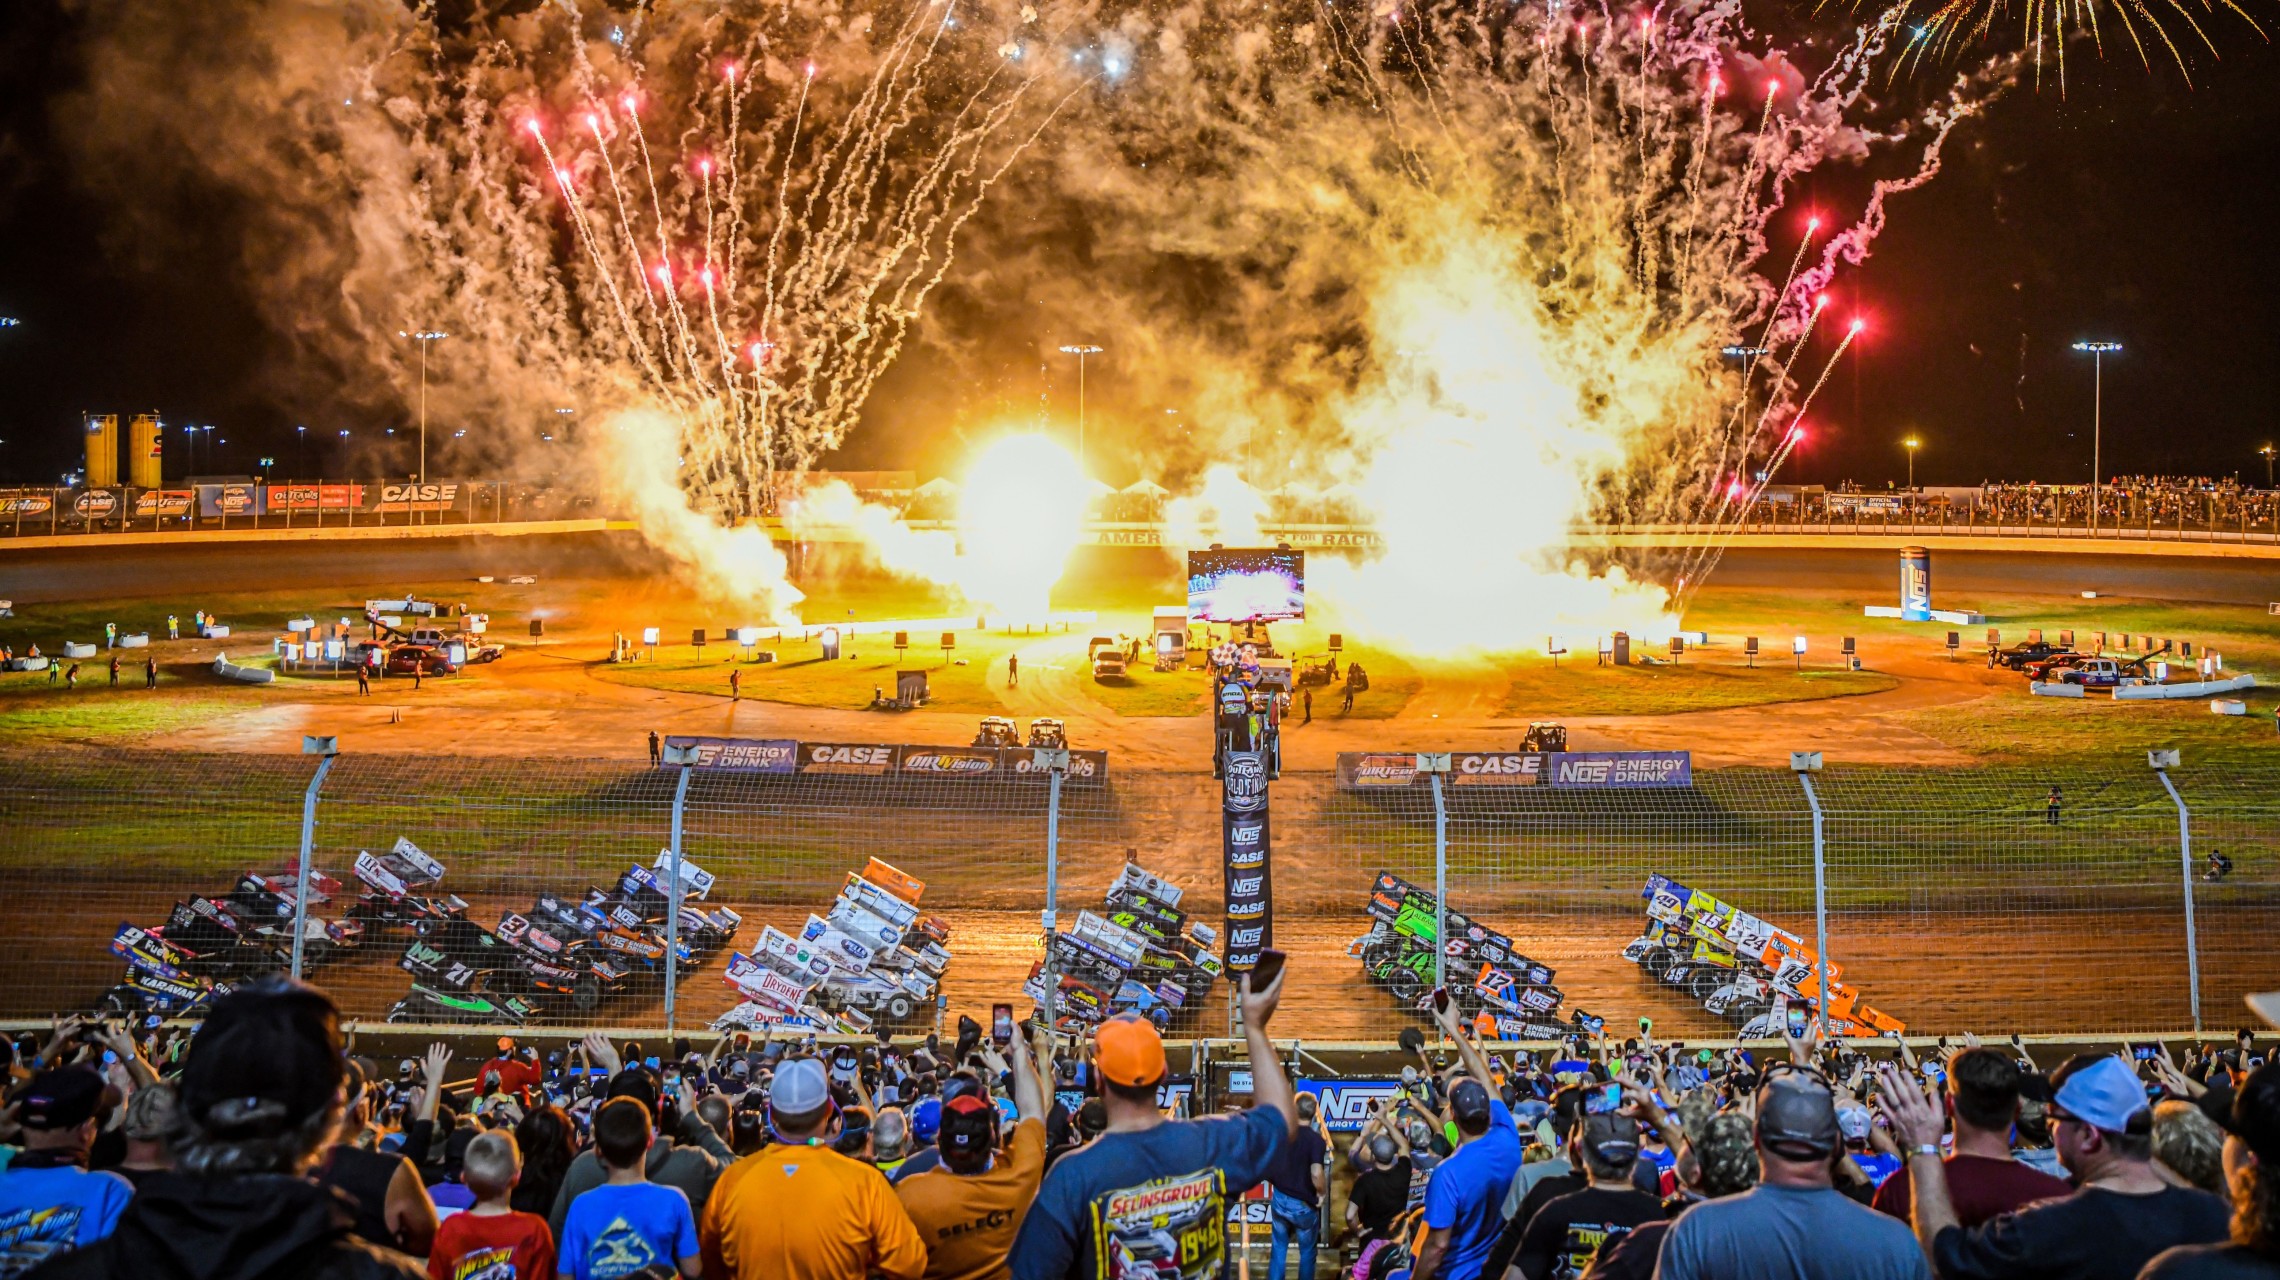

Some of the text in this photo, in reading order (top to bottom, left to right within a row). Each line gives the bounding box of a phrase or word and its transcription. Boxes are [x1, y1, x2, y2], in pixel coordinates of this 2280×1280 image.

[80, 498, 114, 506] CASE
[382, 485, 458, 502] CASE
[1908, 564, 1927, 612] NOS
[723, 746, 791, 757] ENERGY
[811, 746, 892, 764] CASE
[719, 757, 771, 768] DRINK
[1461, 756, 1542, 774] CASE
[1616, 759, 1685, 771] ENERGY
[1558, 760, 1613, 783] NOS
[1614, 771, 1670, 782] DRINK
[1231, 825, 1263, 842] NOS
[1231, 850, 1264, 863] CASE
[1231, 874, 1264, 893] NOS
[1228, 900, 1266, 914] CASE
[1655, 895, 1679, 909] 49
[610, 905, 642, 927] NOS
[1112, 912, 1136, 928] 42
[1698, 912, 1723, 929] 15
[119, 926, 146, 946] 9
[601, 933, 629, 948] NOS
[1231, 925, 1264, 944] NOS
[1743, 933, 1767, 950] 24
[628, 940, 660, 953] ENERGY
[1444, 938, 1470, 956] 5
[1229, 953, 1260, 965] CAS
[1479, 971, 1512, 992] 17
[1779, 965, 1812, 984] 18
[139, 976, 197, 1000] KARAVAN
[762, 972, 804, 1003] DRYDENE
[1521, 987, 1557, 1010] NOS
[1495, 1018, 1526, 1033] NOS
[1526, 1024, 1562, 1035] ENERGY
[1812, 1014, 1854, 1029] APEN
[1523, 1029, 1552, 1039] DRINK
[1319, 1085, 1394, 1119] NO
[1108, 1178, 1212, 1218] SELINSGROVE
[1181, 1217, 1218, 1265] 1946
